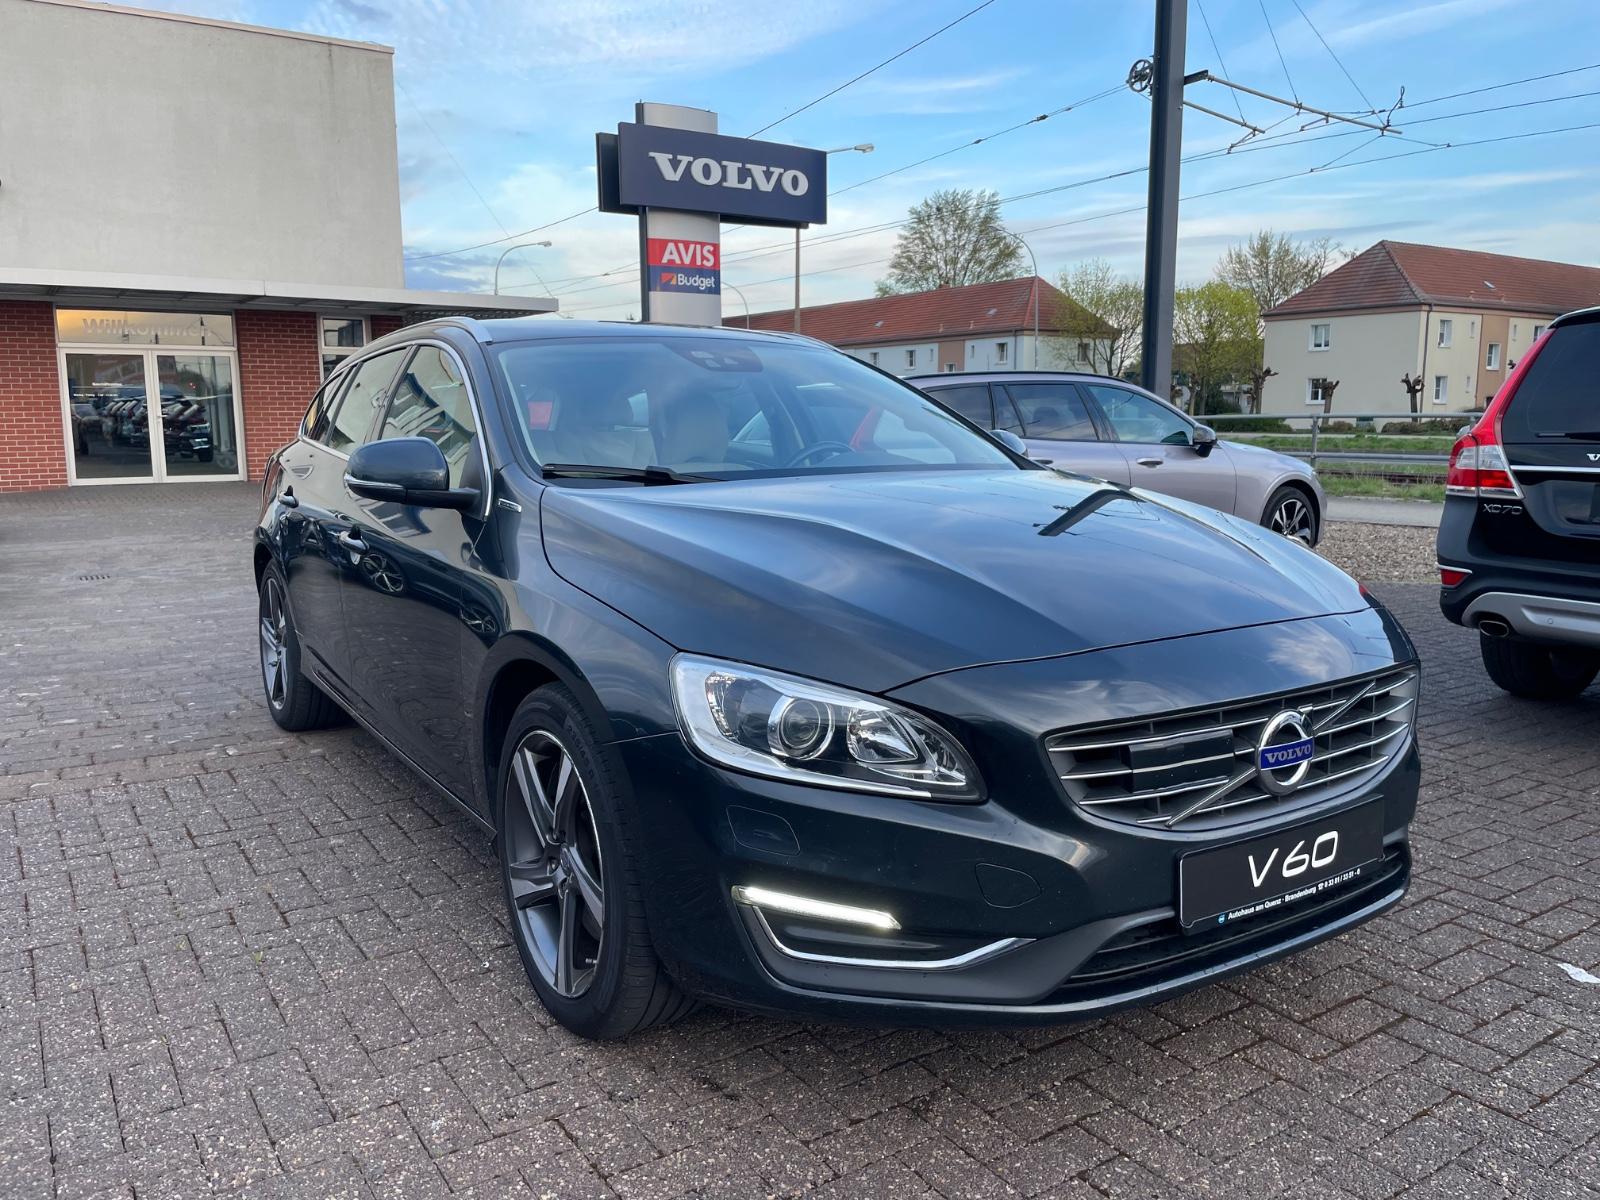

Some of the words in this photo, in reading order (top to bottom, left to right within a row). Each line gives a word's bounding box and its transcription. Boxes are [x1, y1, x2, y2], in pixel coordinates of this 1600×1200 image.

[648, 152, 809, 197] VOLVO
[661, 242, 715, 267] AVIS
[677, 273, 716, 290] Budget
[82, 317, 213, 337] Willkommen
[1483, 503, 1523, 515] XC70
[1264, 744, 1312, 763] VOLVO
[1227, 906, 1255, 920] Autohaus
[1255, 904, 1264, 912] am
[1264, 898, 1282, 909] Quenz
[1284, 886, 1317, 903] Brandenburg
